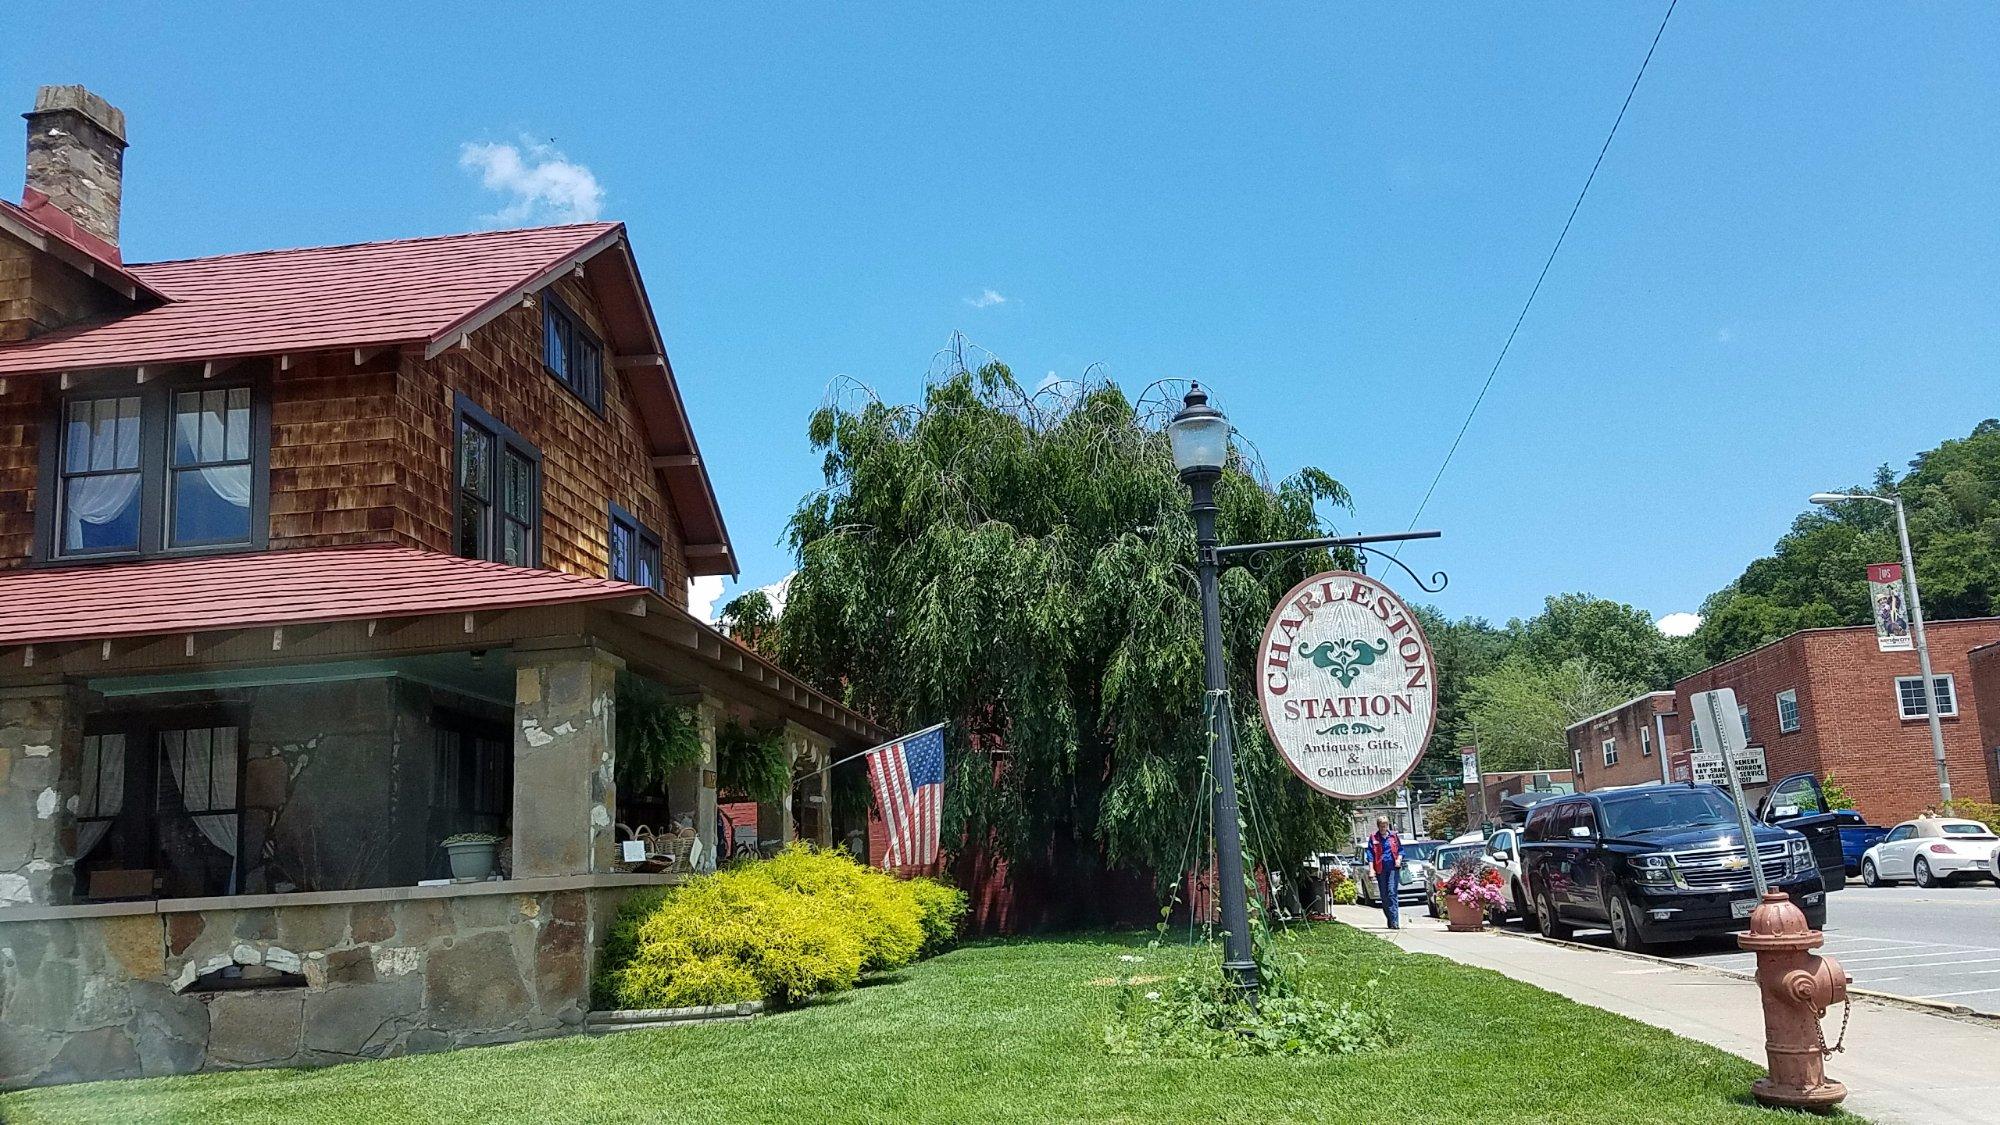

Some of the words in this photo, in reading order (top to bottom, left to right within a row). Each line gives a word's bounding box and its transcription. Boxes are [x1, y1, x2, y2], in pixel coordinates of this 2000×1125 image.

[1268, 581, 1427, 696] CHARLESTON
[1284, 693, 1413, 721] STATION
[1303, 742, 1364, 754] Antiques,
[1367, 739, 1403, 751] Gifts,
[1347, 752, 1360, 764] &
[1317, 765, 1393, 778] Collectibles
